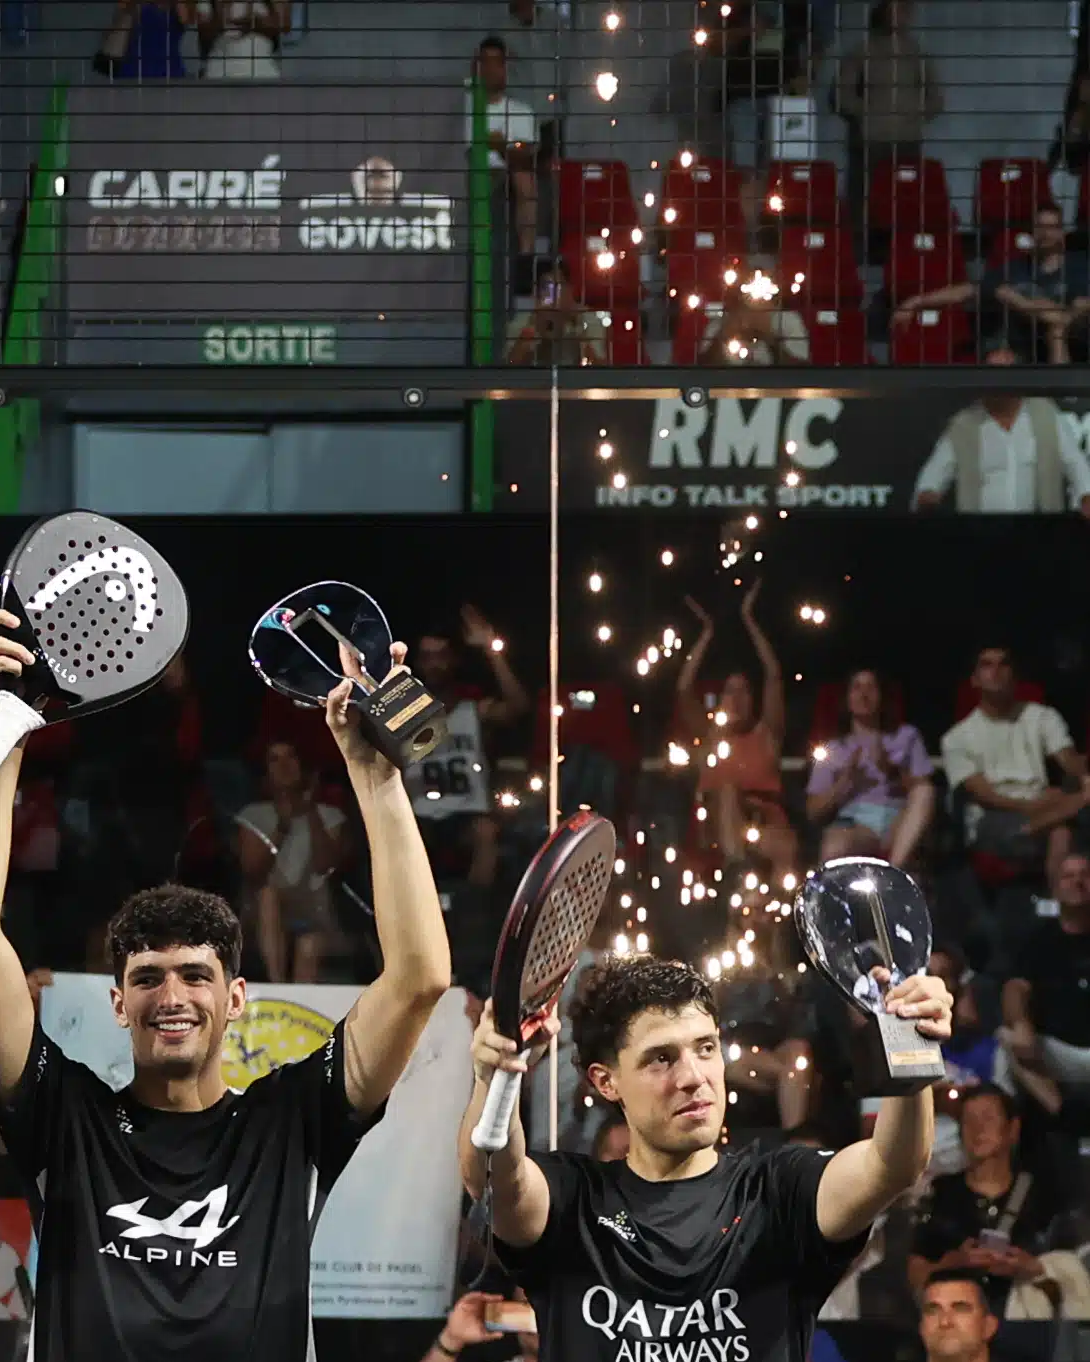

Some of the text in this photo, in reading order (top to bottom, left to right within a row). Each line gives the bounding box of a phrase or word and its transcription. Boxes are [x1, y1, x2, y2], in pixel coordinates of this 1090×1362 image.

[88, 154, 283, 210] CARRÉ
[203, 325, 338, 363] SORTIE
[648, 397, 844, 470] RMC
[595, 484, 893, 508] INFO TALK SPORT
[98, 1239, 239, 1269] ALPINE
[581, 1285, 747, 1341] QATAR
